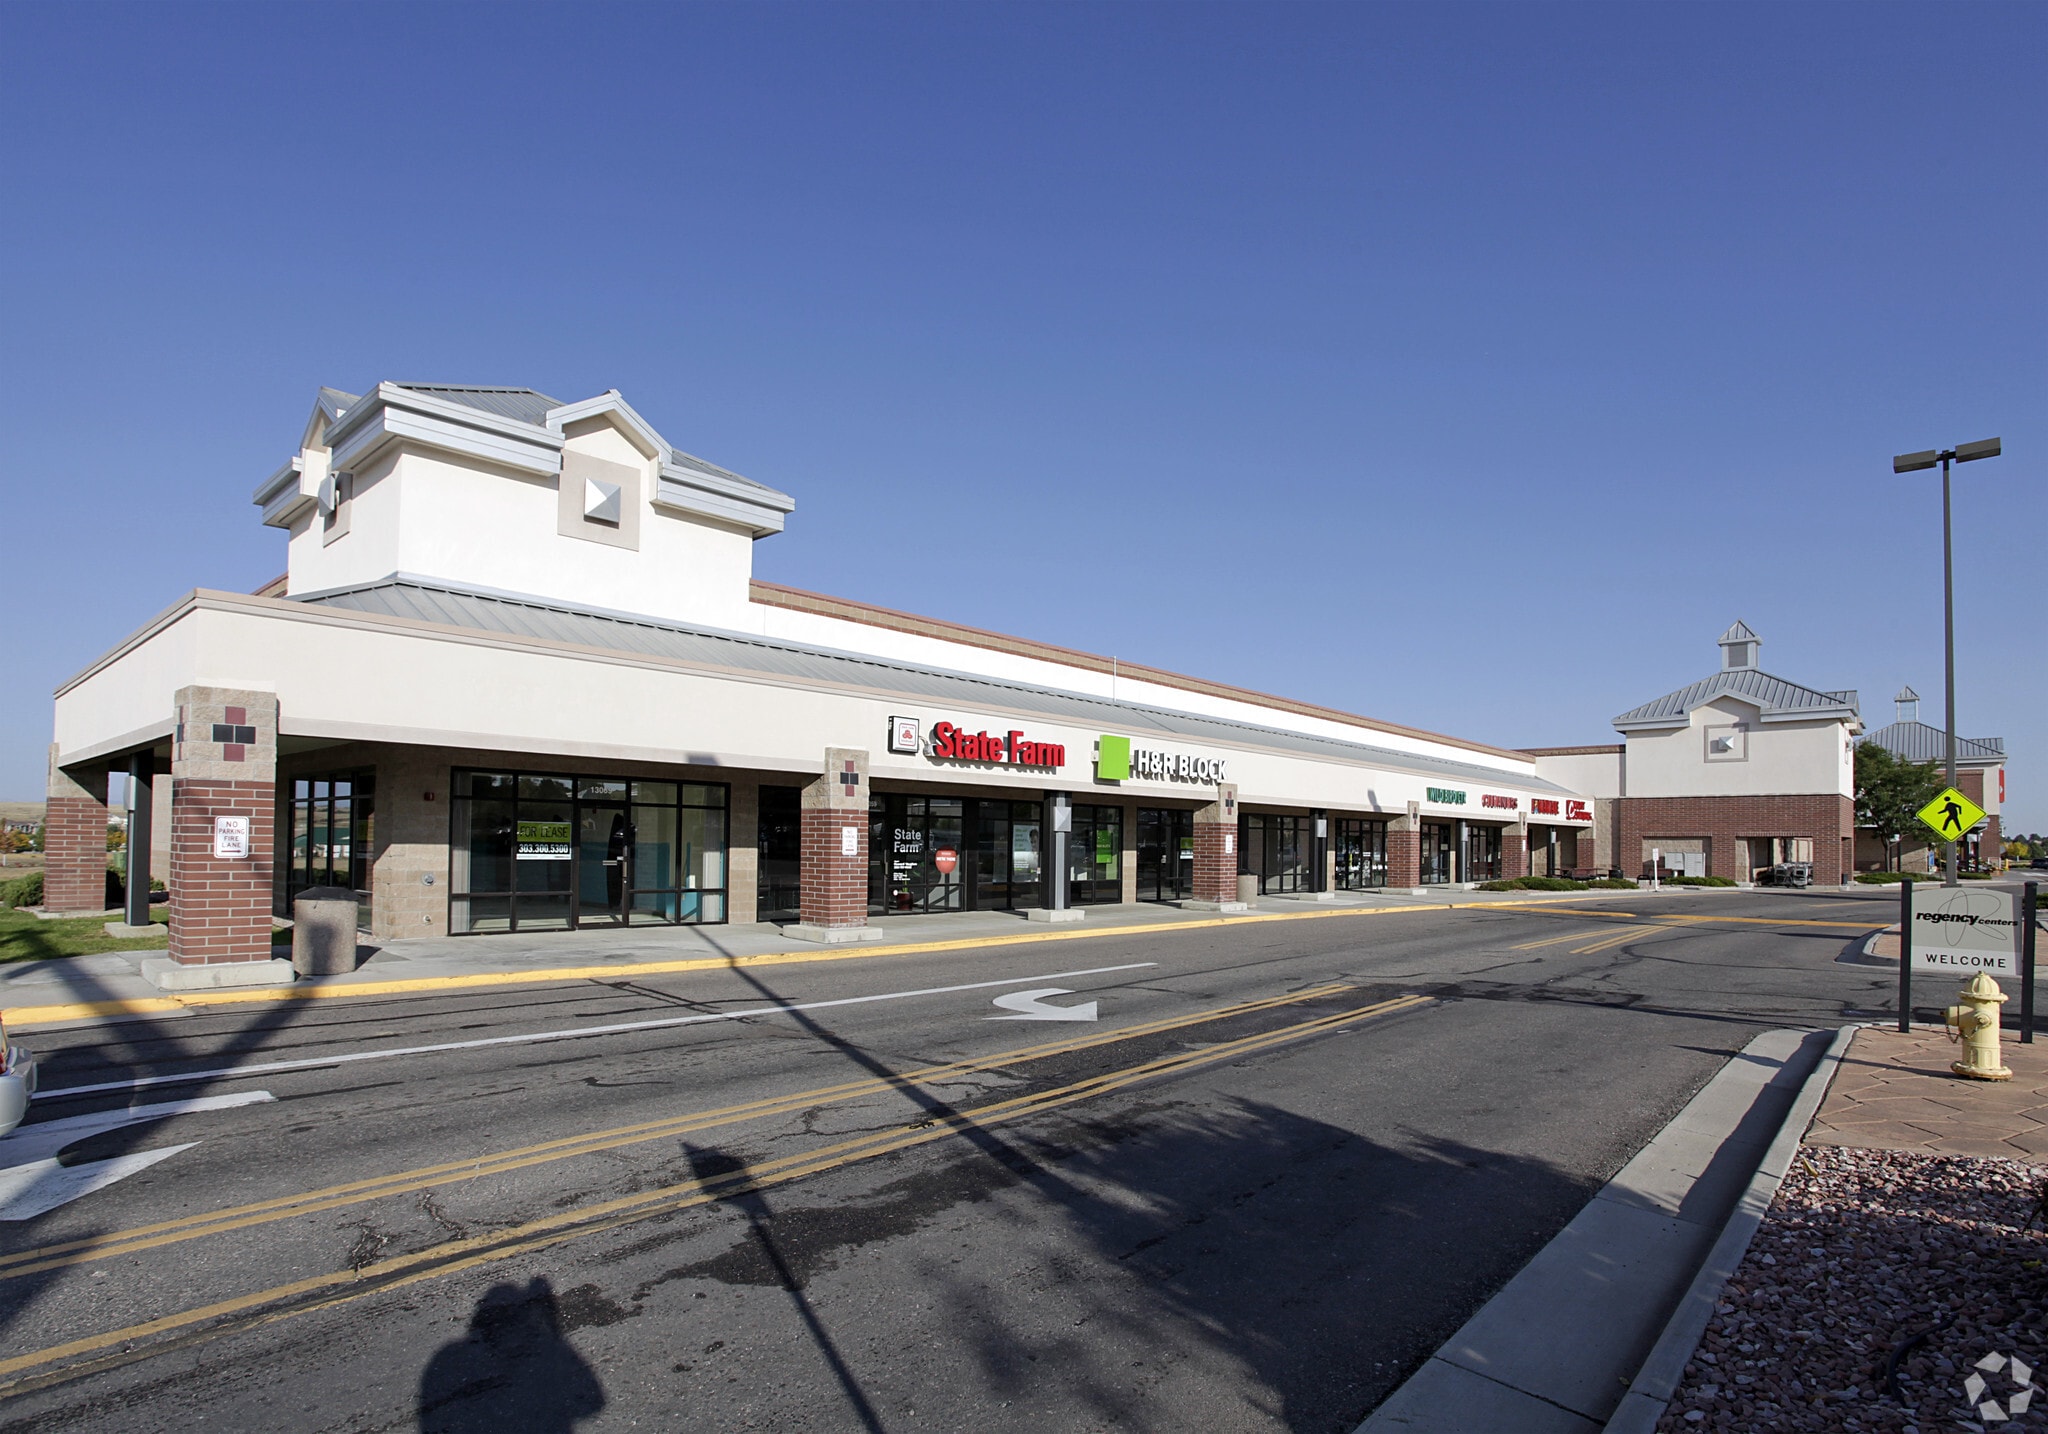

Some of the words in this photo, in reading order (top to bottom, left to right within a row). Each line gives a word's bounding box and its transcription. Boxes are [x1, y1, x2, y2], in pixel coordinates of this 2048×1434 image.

[935, 720, 1003, 762] State
[1007, 730, 1065, 767] Farm
[1136, 750, 1175, 775] H&R
[1179, 755, 1227, 781] BLOCK
[226, 820, 239, 828] NO
[520, 826, 537, 838] FOR
[541, 826, 568, 839] LEASE
[894, 828, 922, 840] State
[518, 843, 568, 853] 303.300.5300
[893, 841, 919, 853] Farm
[1916, 912, 1979, 926] regency
[1978, 918, 2019, 926] centers
[1926, 953, 2007, 968] WELCOME
